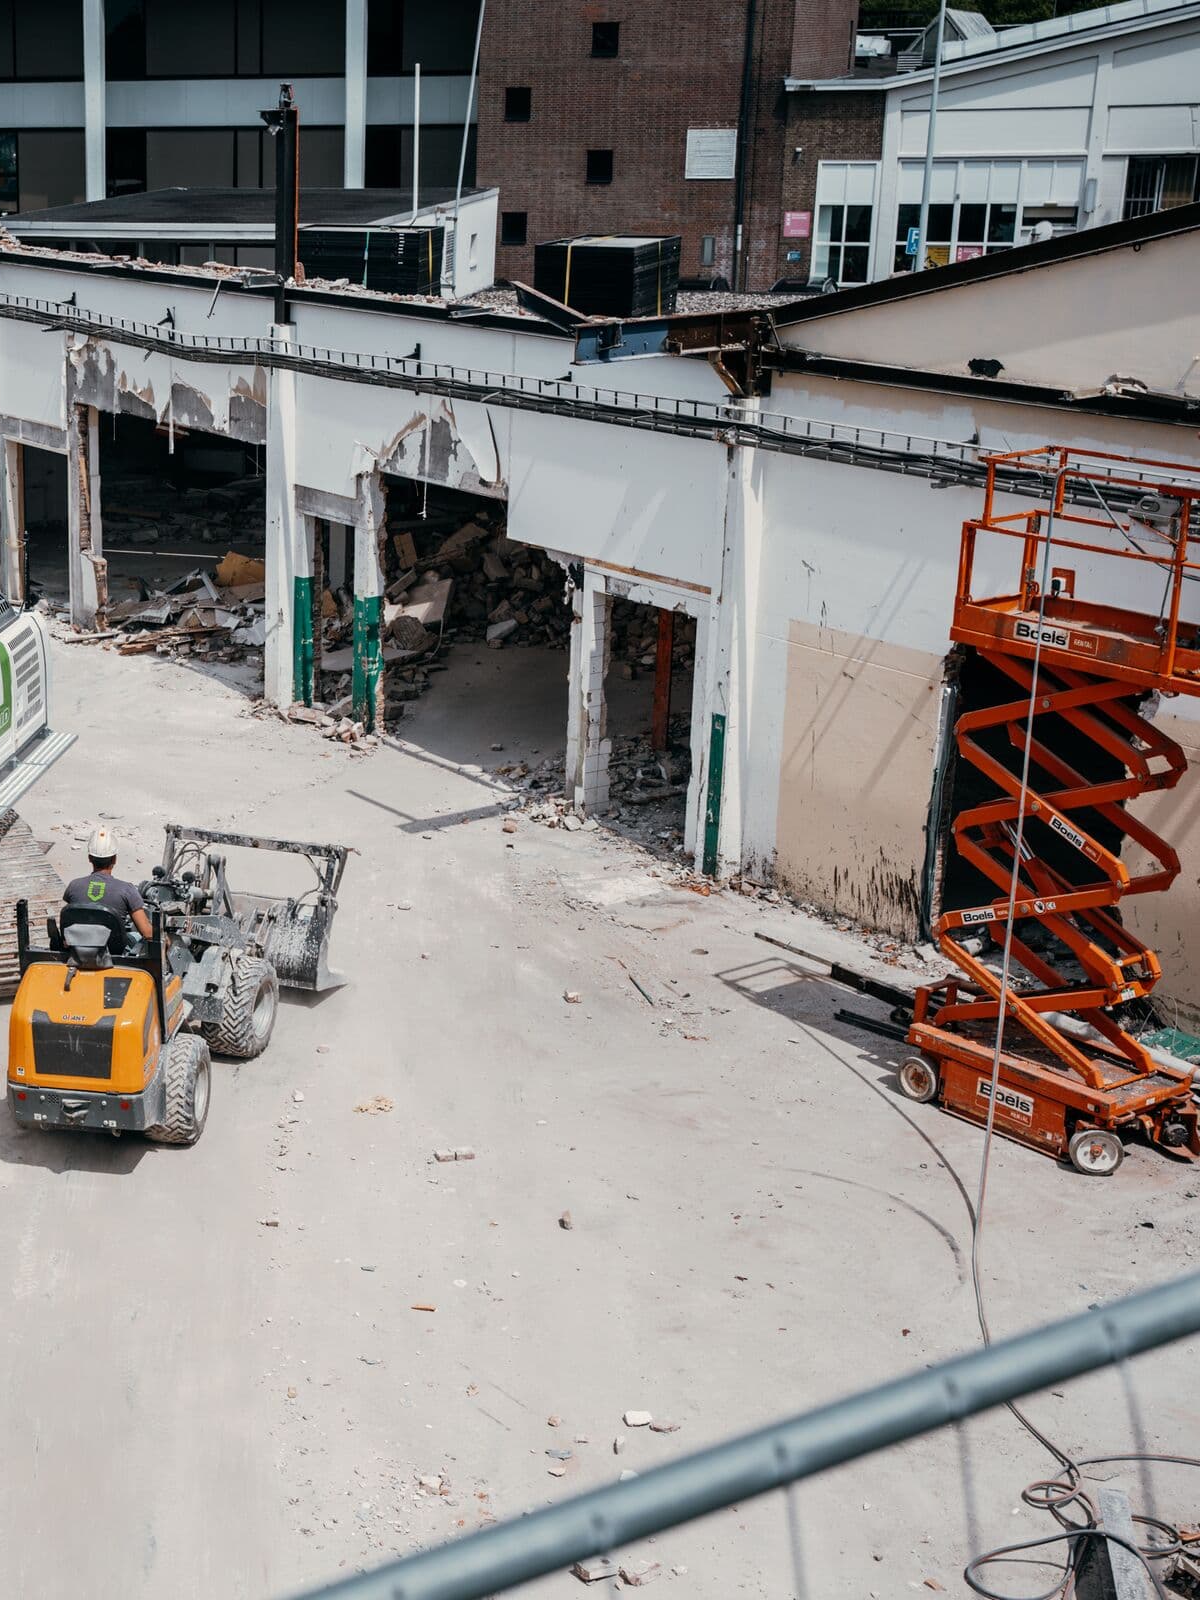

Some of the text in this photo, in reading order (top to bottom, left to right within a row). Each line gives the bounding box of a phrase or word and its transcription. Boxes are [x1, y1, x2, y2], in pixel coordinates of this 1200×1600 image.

[1015, 622, 1067, 646] Boels
[1051, 818, 1082, 847] Boels
[963, 911, 994, 922] Boels
